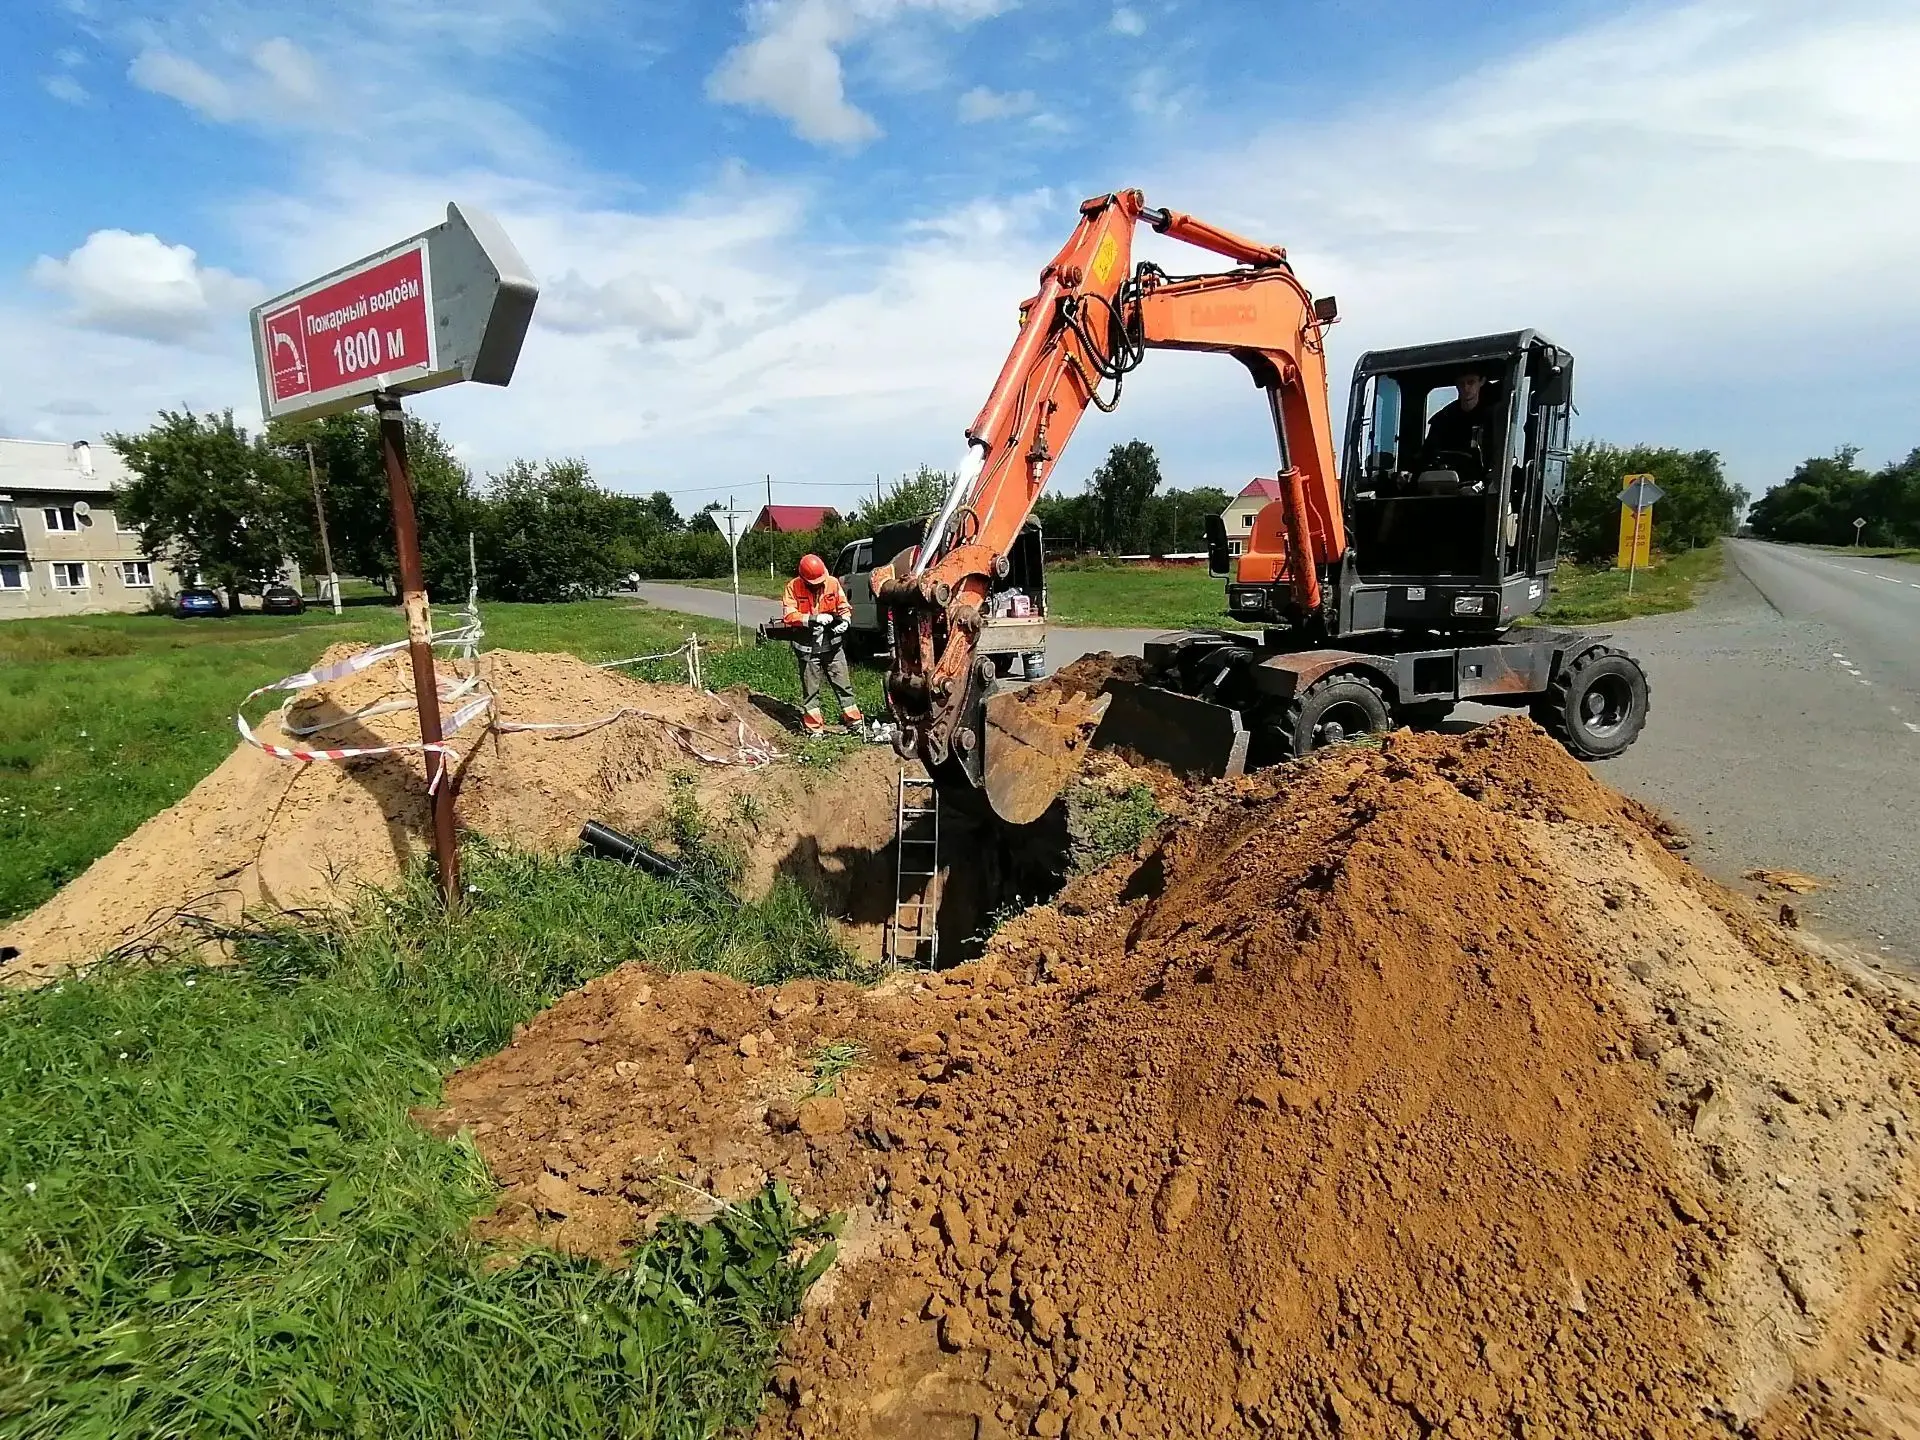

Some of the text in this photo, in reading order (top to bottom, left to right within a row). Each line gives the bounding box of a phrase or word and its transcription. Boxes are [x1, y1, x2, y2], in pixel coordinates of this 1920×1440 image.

[306, 278, 419, 336] Пожарный водоём
[333, 327, 381, 375] 1800
